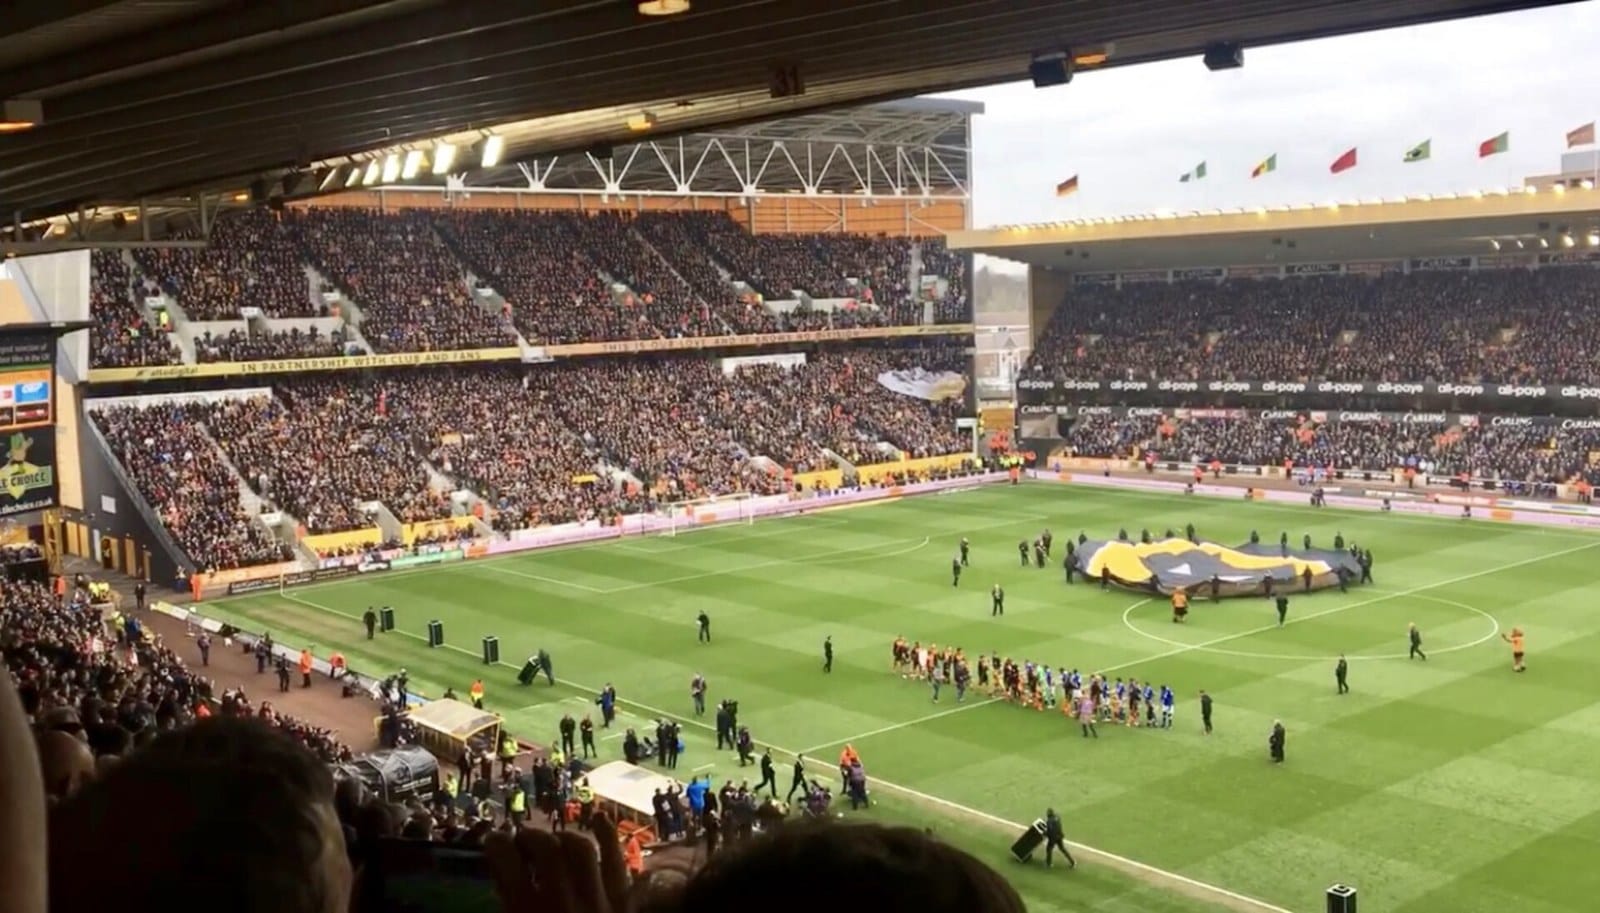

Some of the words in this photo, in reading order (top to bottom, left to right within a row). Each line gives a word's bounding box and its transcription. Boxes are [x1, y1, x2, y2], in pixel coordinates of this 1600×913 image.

[241, 363, 257, 372] IN
[262, 359, 348, 371] PARTNERSHIP
[354, 356, 386, 366] WITH
[391, 354, 420, 363] CLUB
[425, 352, 449, 361] AND
[10, 472, 49, 487] CHOICE
